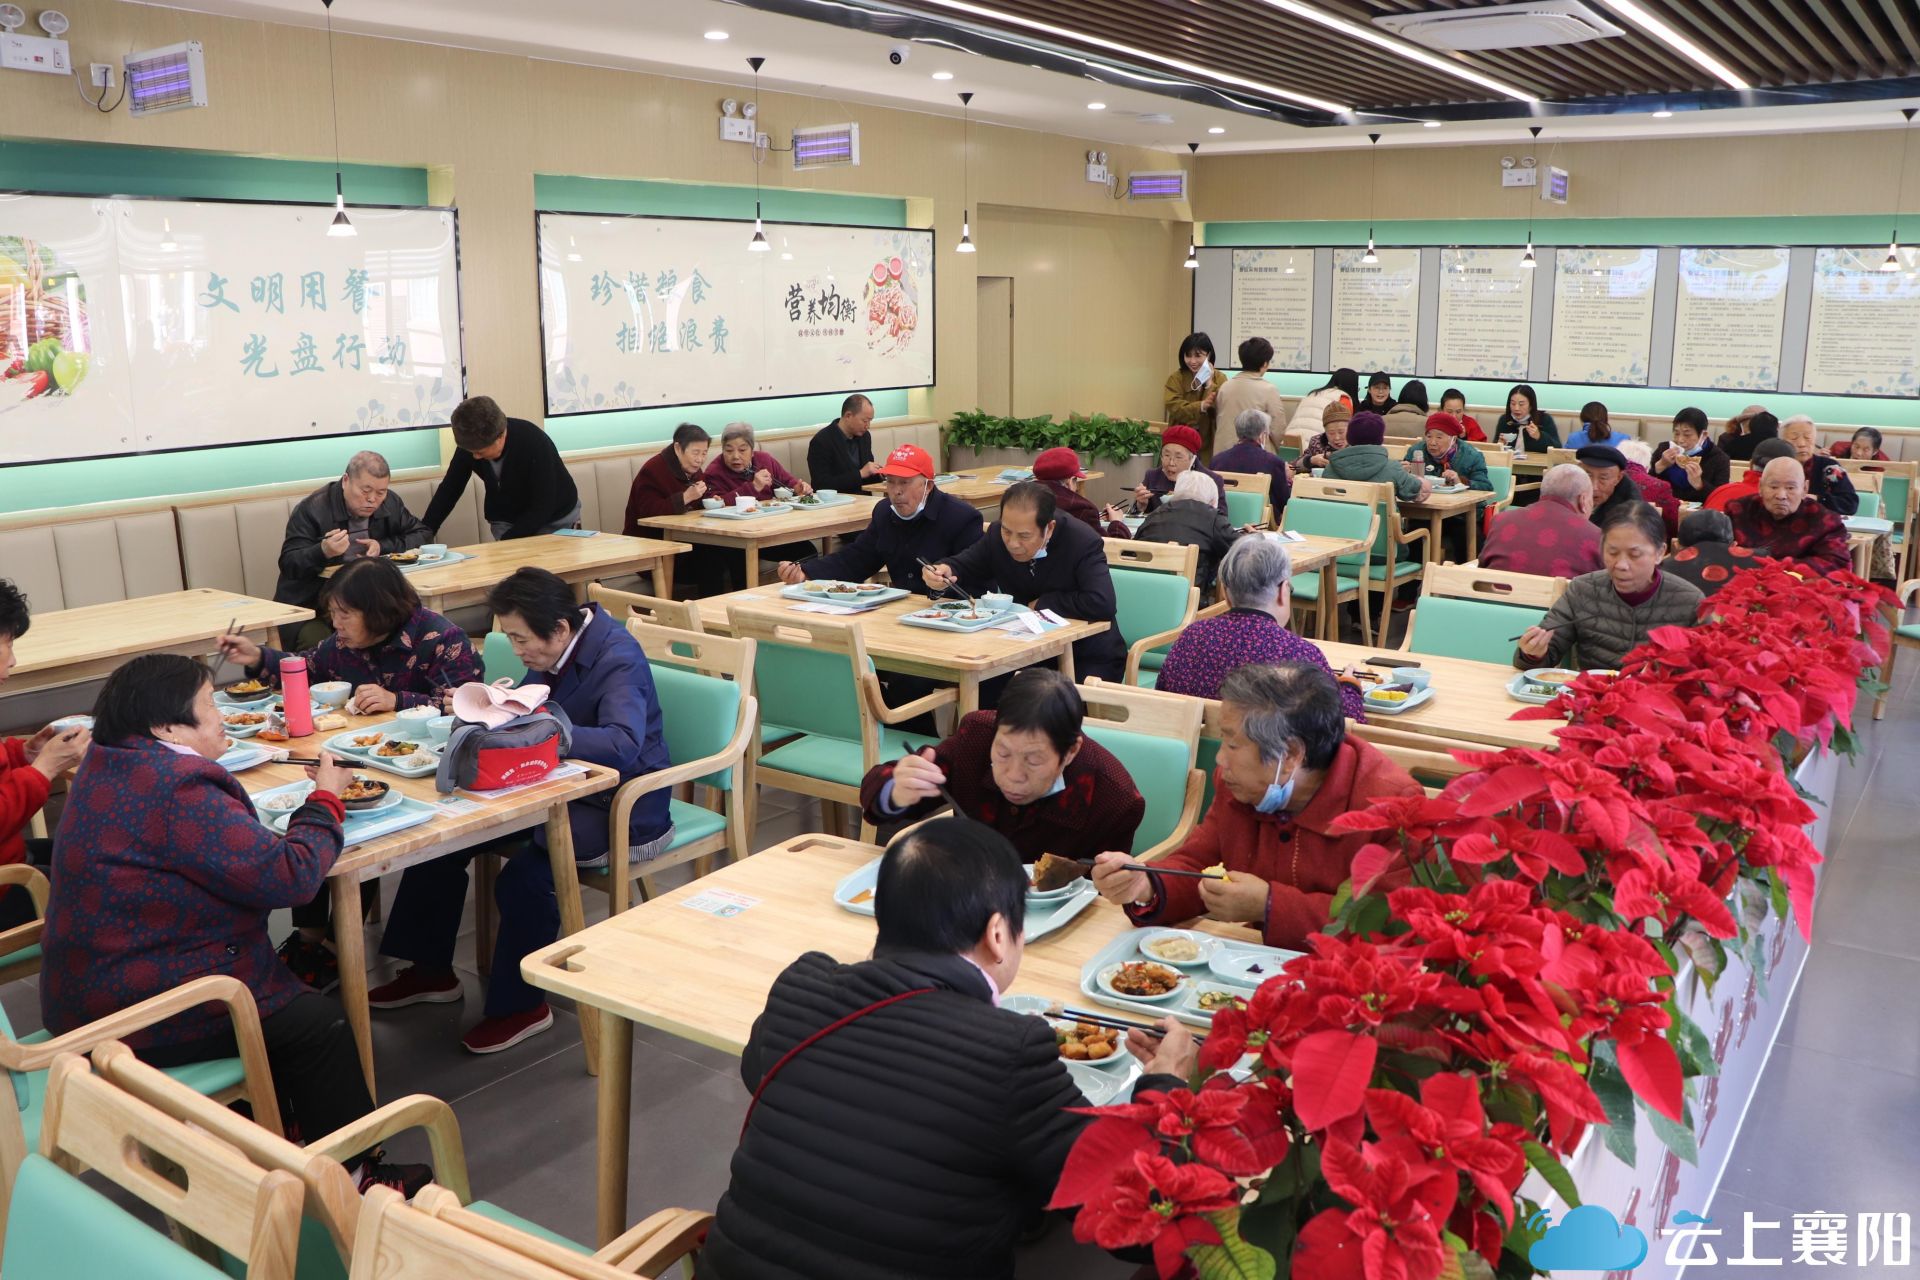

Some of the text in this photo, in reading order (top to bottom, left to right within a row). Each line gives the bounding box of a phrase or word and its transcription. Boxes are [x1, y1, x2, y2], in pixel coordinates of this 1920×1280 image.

[199, 267, 380, 314] 文明用餐
[784, 282, 858, 326] 营养均衡
[239, 332, 407, 378] 光盘行动
[615, 314, 729, 355] 拒绝浪费
